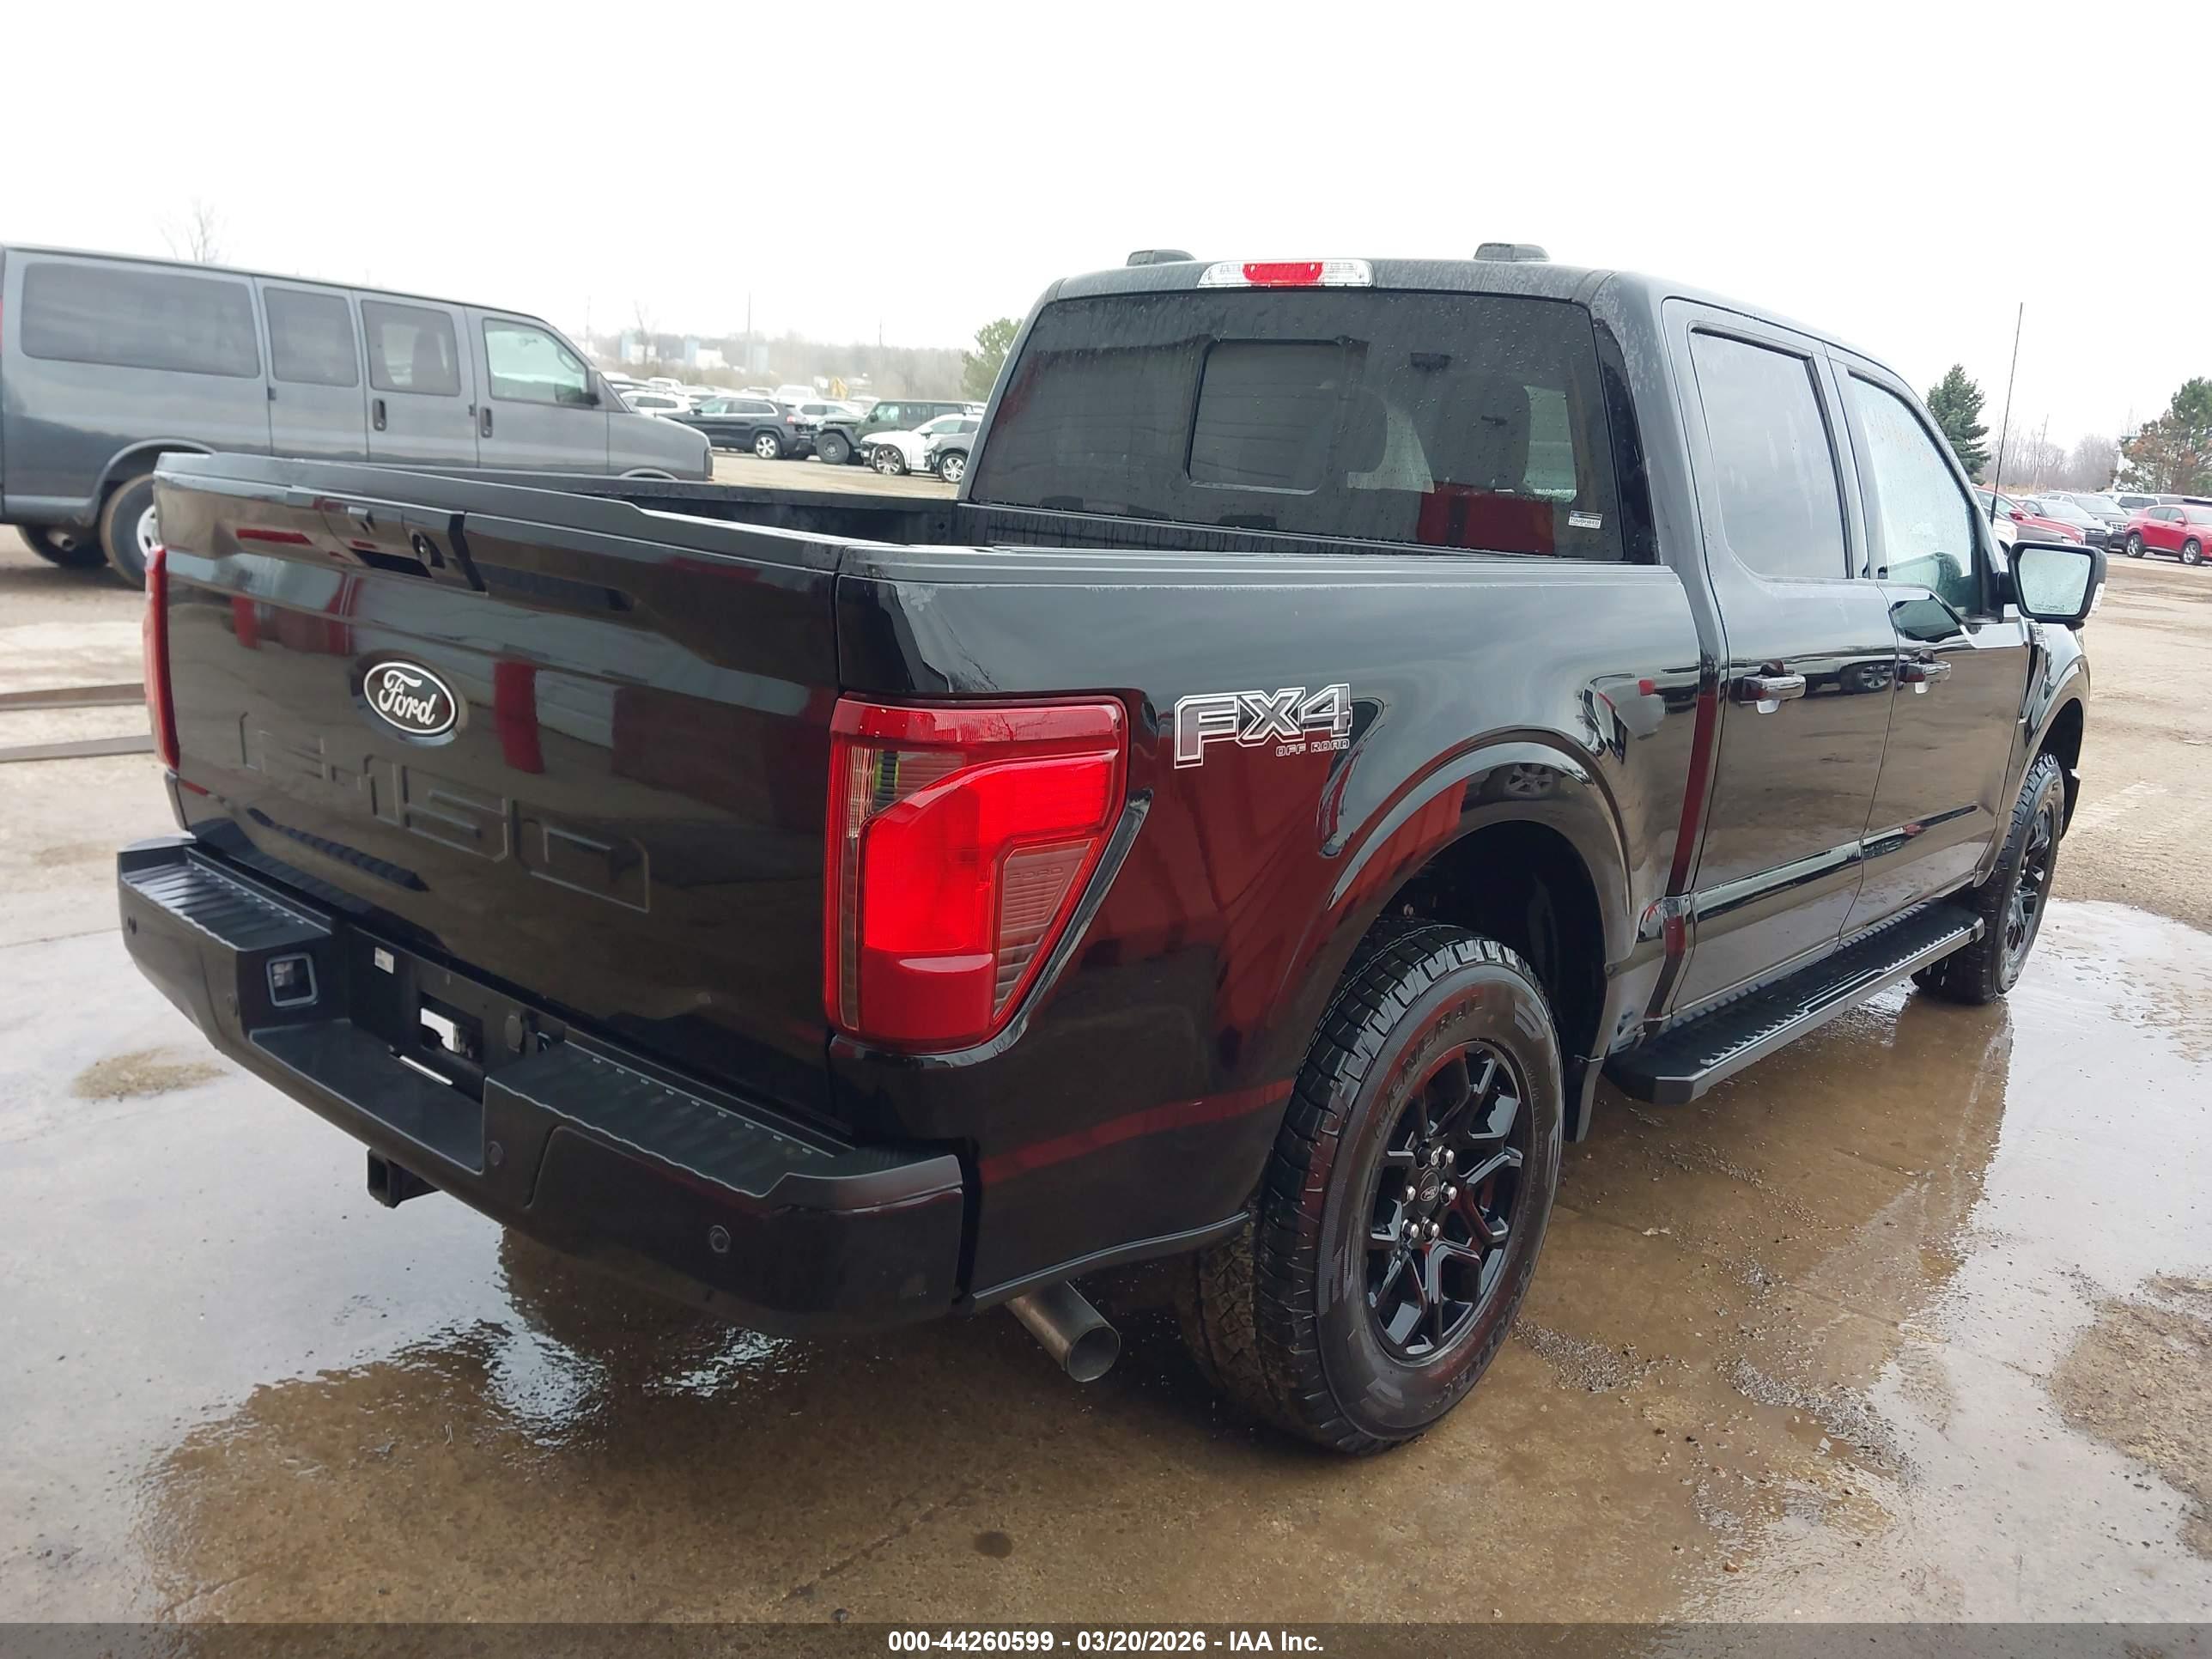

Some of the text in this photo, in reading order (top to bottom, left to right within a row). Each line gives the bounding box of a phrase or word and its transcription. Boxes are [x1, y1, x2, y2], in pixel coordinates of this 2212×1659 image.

[378, 669, 437, 726] Ford
[1174, 683, 1353, 770] FX4
[1275, 738, 1350, 757] OFF ROAD
[1006, 867, 1063, 881] FORD
[1374, 993, 1485, 1139] GENERAL
